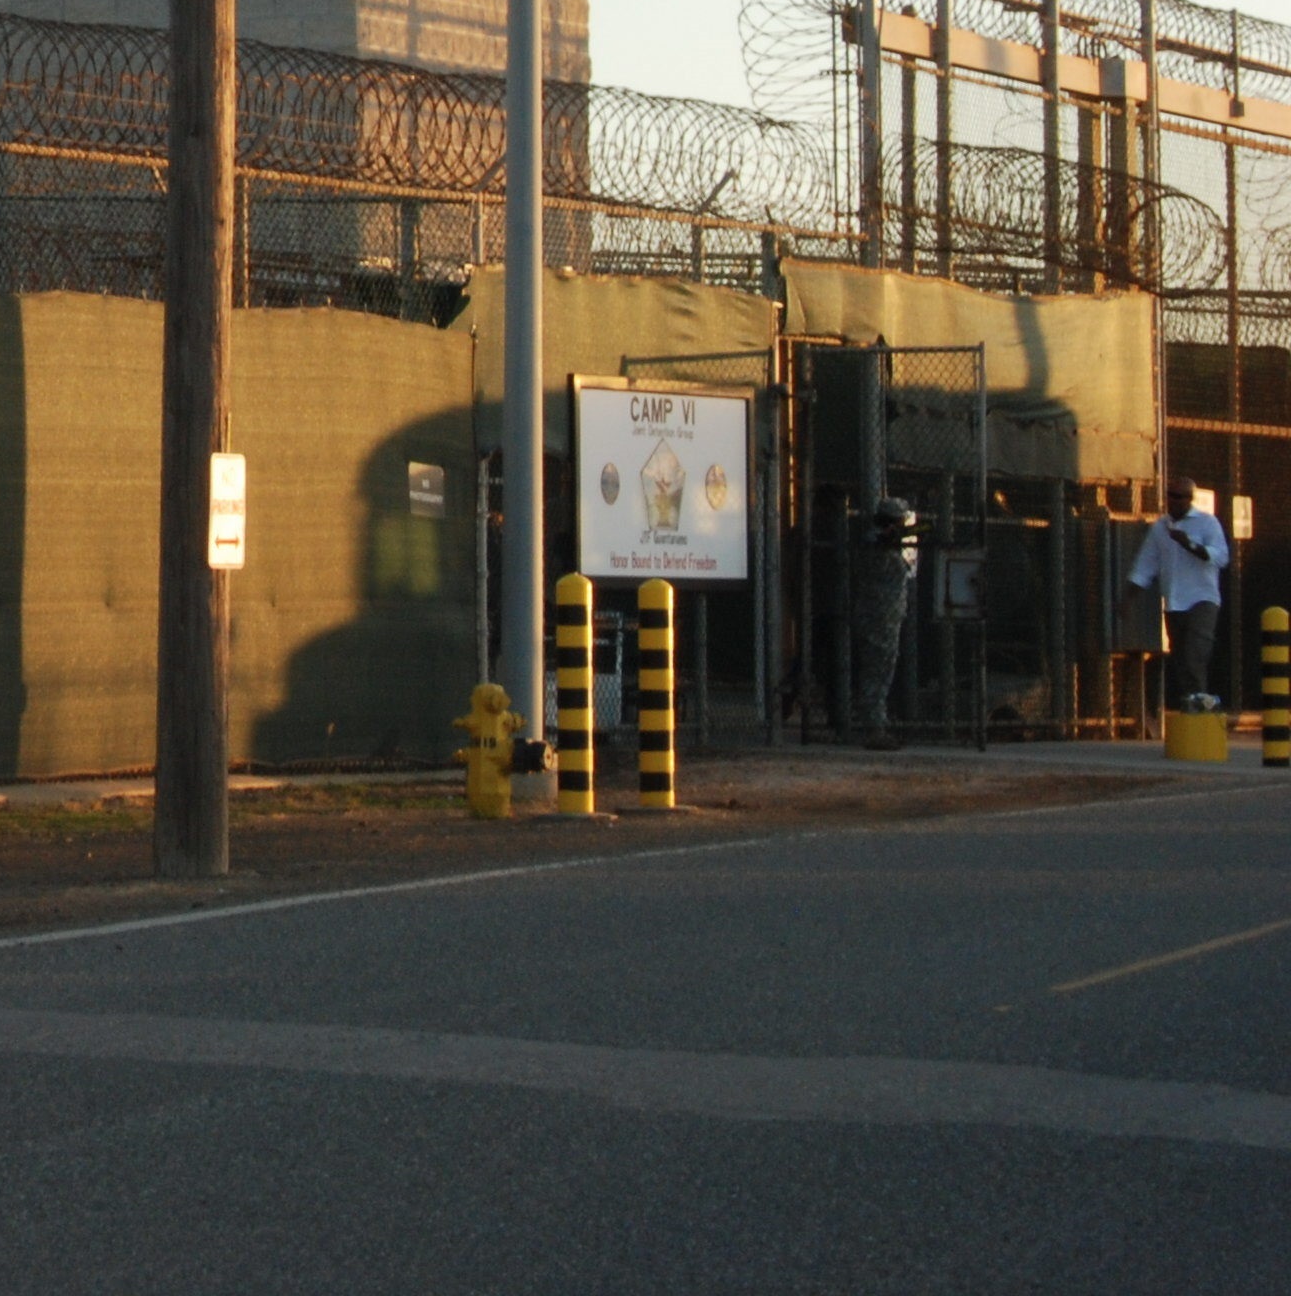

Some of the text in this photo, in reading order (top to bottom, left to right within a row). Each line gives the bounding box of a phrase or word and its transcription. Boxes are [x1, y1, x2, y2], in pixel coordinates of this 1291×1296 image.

[630, 396, 695, 425] CAMP VI
[610, 550, 628, 569] Honor
[631, 551, 652, 570] Bound
[663, 551, 687, 570] Defend
[688, 552, 717, 571] Freedom
